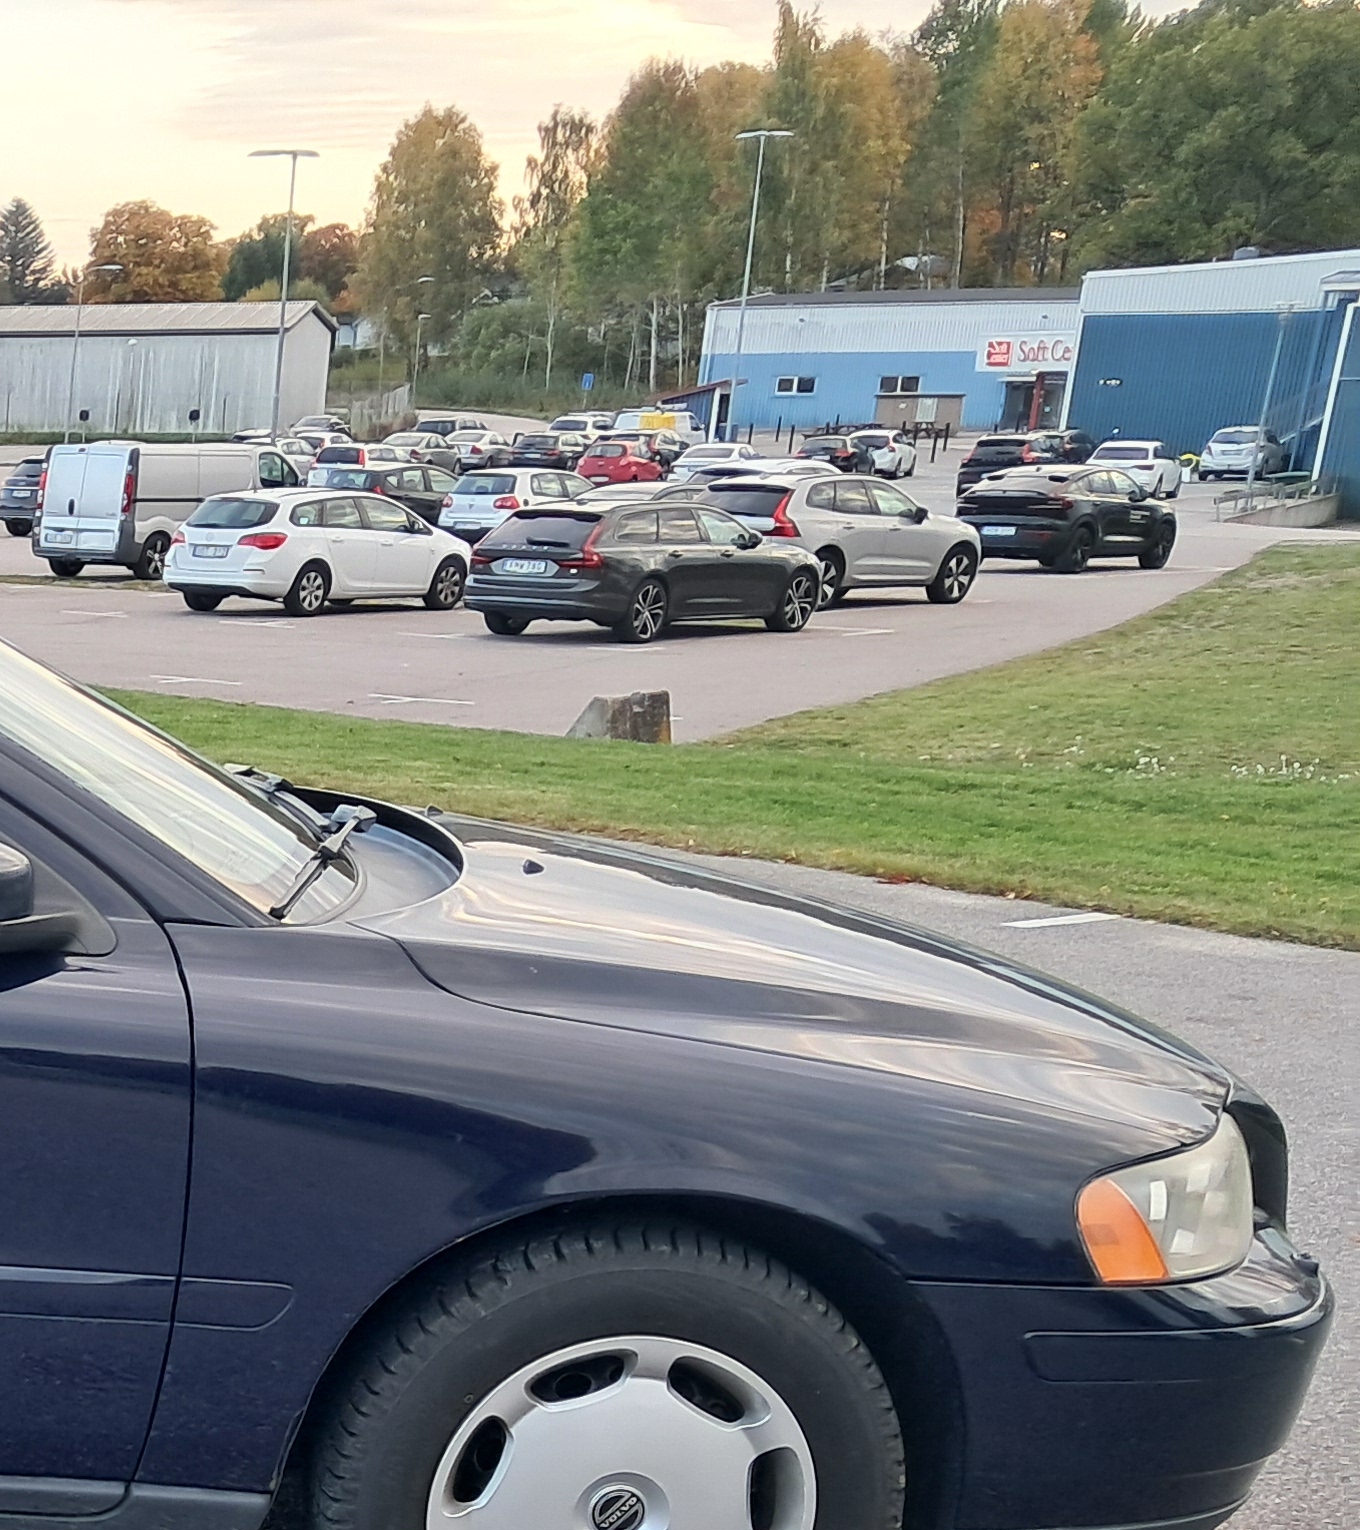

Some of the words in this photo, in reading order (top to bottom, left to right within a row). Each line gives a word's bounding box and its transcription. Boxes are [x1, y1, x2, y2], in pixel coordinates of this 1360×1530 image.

[1017, 339, 1049, 362] Soft
[1051, 339, 1074, 362] Ce
[599, 1496, 638, 1528] VOLVO
